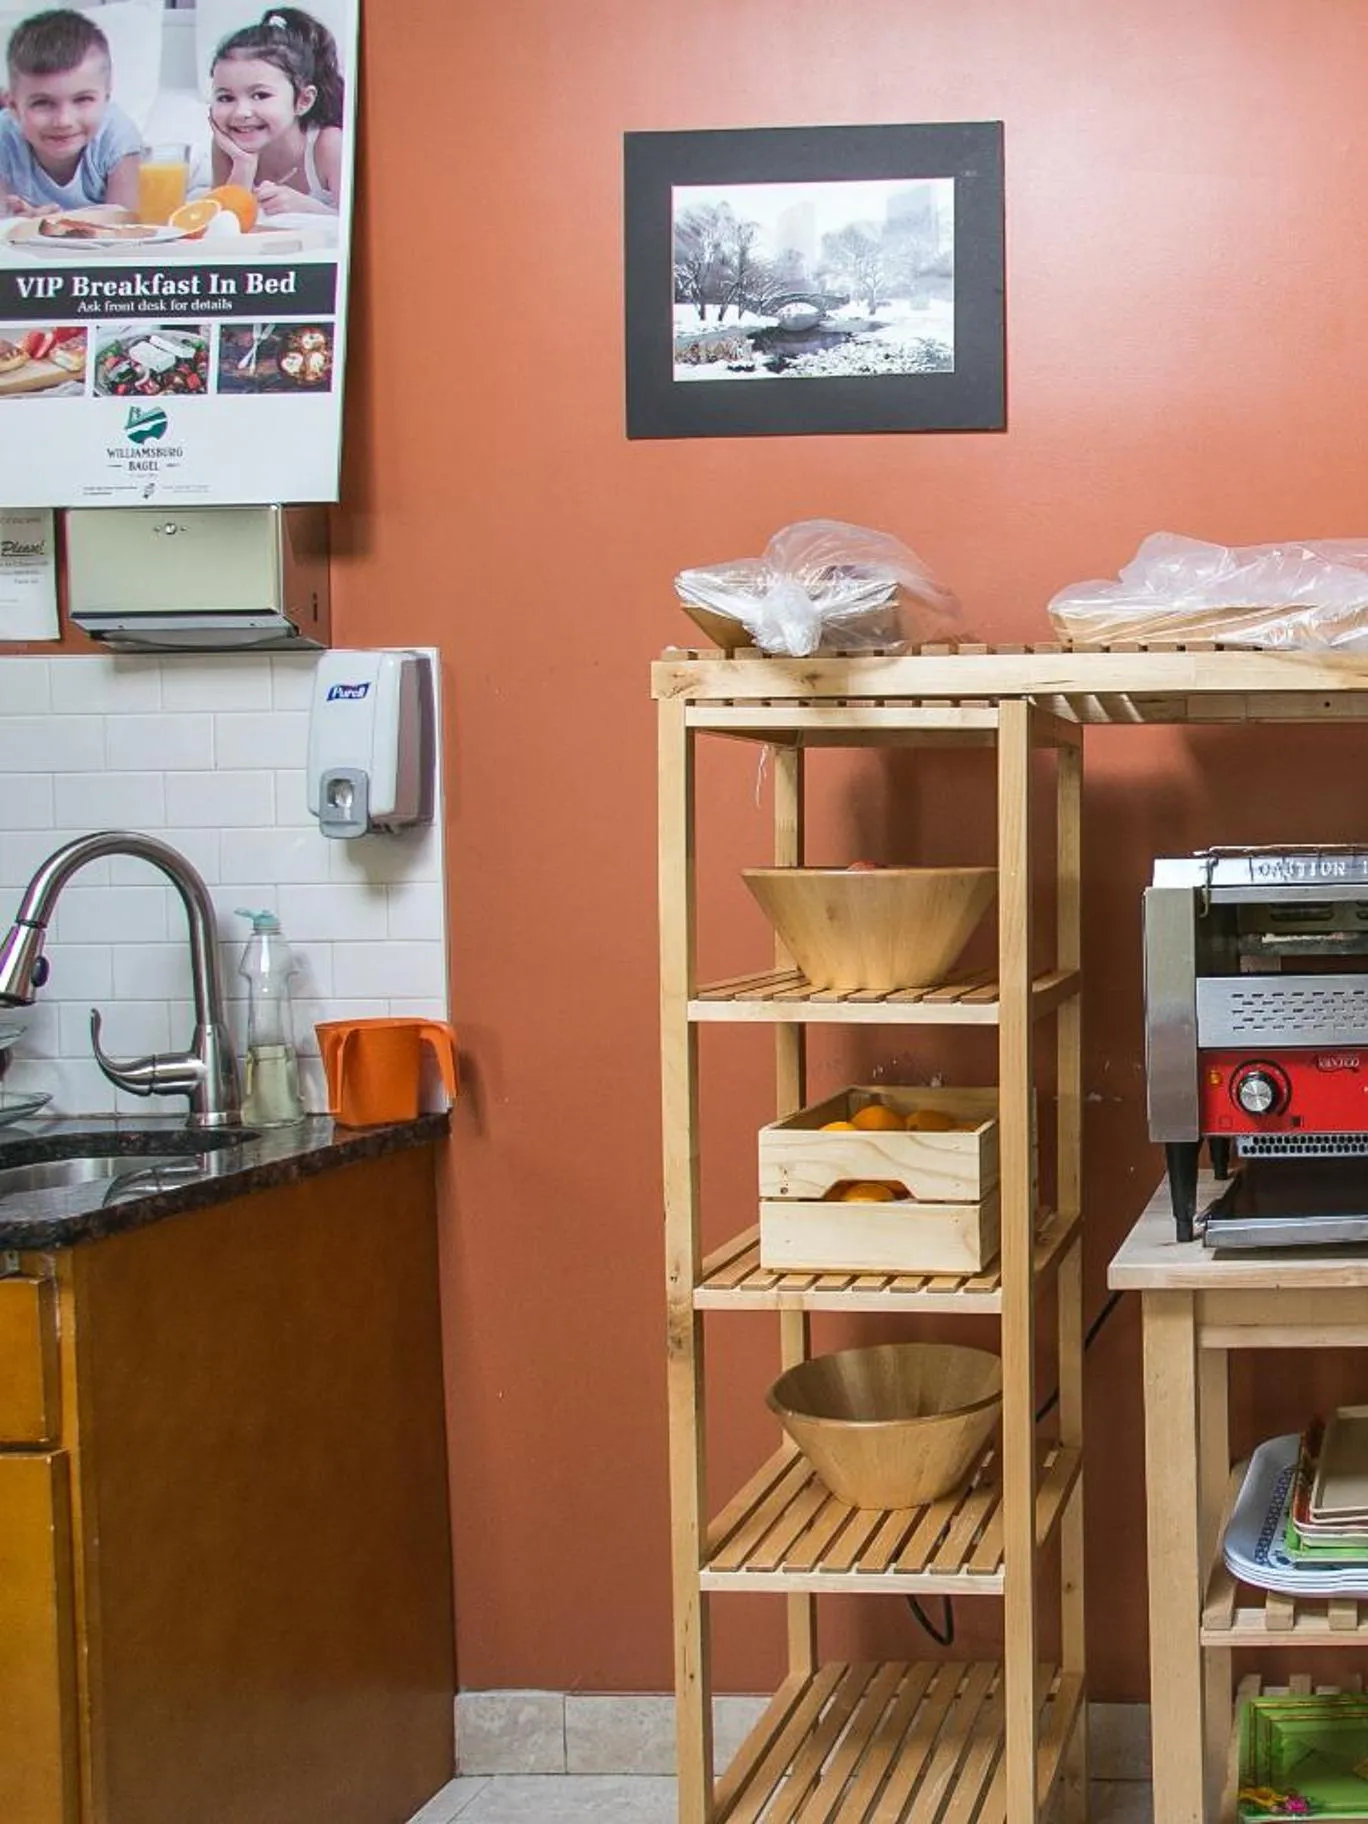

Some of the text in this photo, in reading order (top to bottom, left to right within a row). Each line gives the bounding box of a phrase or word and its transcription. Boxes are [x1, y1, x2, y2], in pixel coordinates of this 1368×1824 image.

[16, 271, 296, 298] VIP Breakfast In Bed
[77, 298, 233, 313] Ask front desk for details
[107, 447, 183, 458] WILLIAMSBURG
[128, 461, 159, 471] BAGEL
